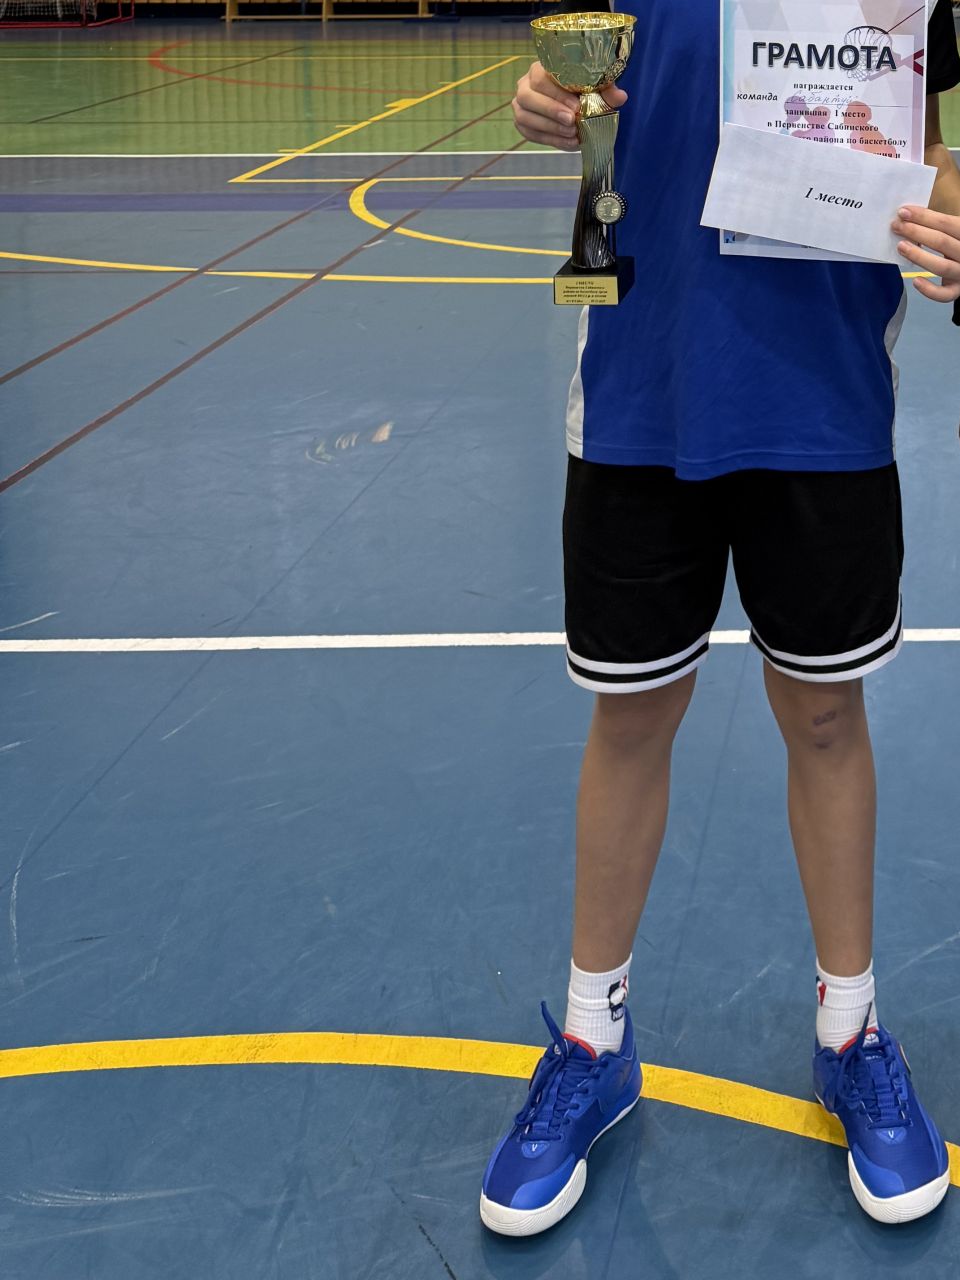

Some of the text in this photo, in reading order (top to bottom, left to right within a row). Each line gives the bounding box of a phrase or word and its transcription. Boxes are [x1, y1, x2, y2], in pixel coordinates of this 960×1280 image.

[752, 41, 897, 71] ГРАМОТА
[793, 83, 853, 91] награждается
[737, 92, 778, 101] команда
[775, 120, 825, 130] Первенстве
[827, 122, 879, 132] Сабинского
[846, 137, 857, 145] по
[859, 137, 907, 147] баскетболу
[814, 192, 863, 209] место
